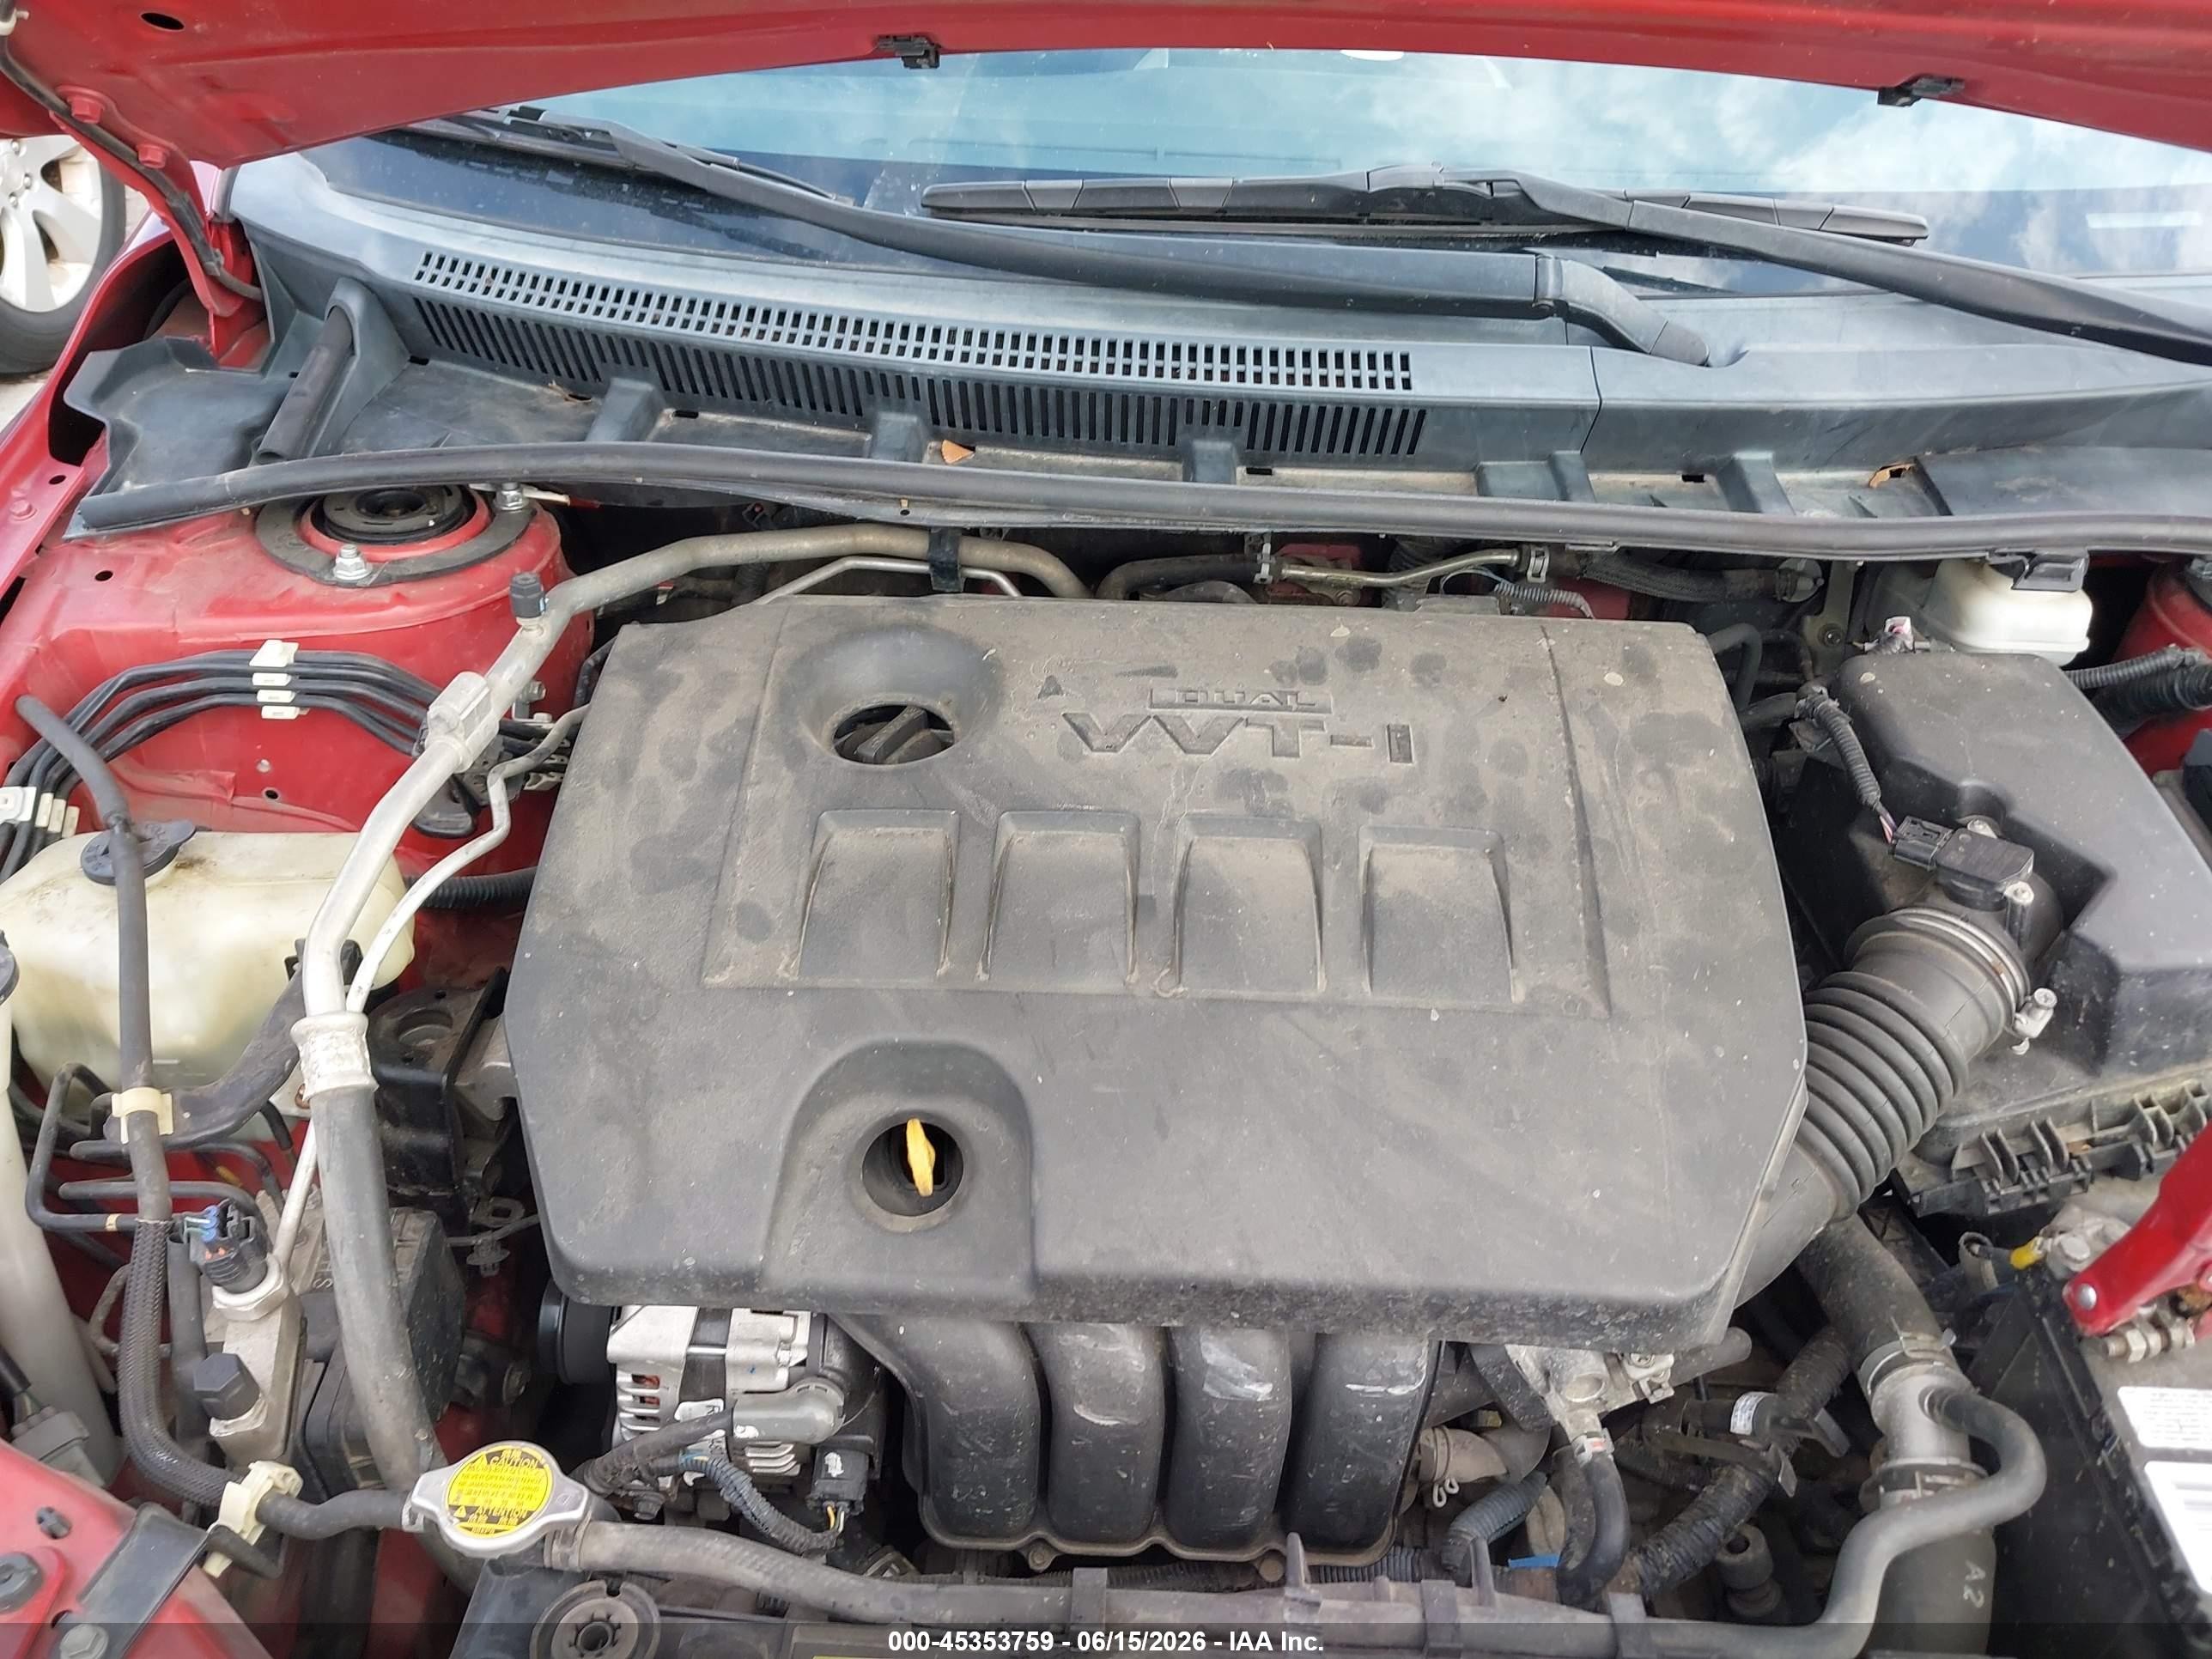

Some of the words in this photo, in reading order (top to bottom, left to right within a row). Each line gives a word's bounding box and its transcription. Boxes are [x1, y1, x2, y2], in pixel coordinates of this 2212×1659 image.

[1175, 688, 1316, 710] DUAL
[489, 1455, 538, 1469] CAUTION
[475, 1505, 529, 1519] ATTENTION
